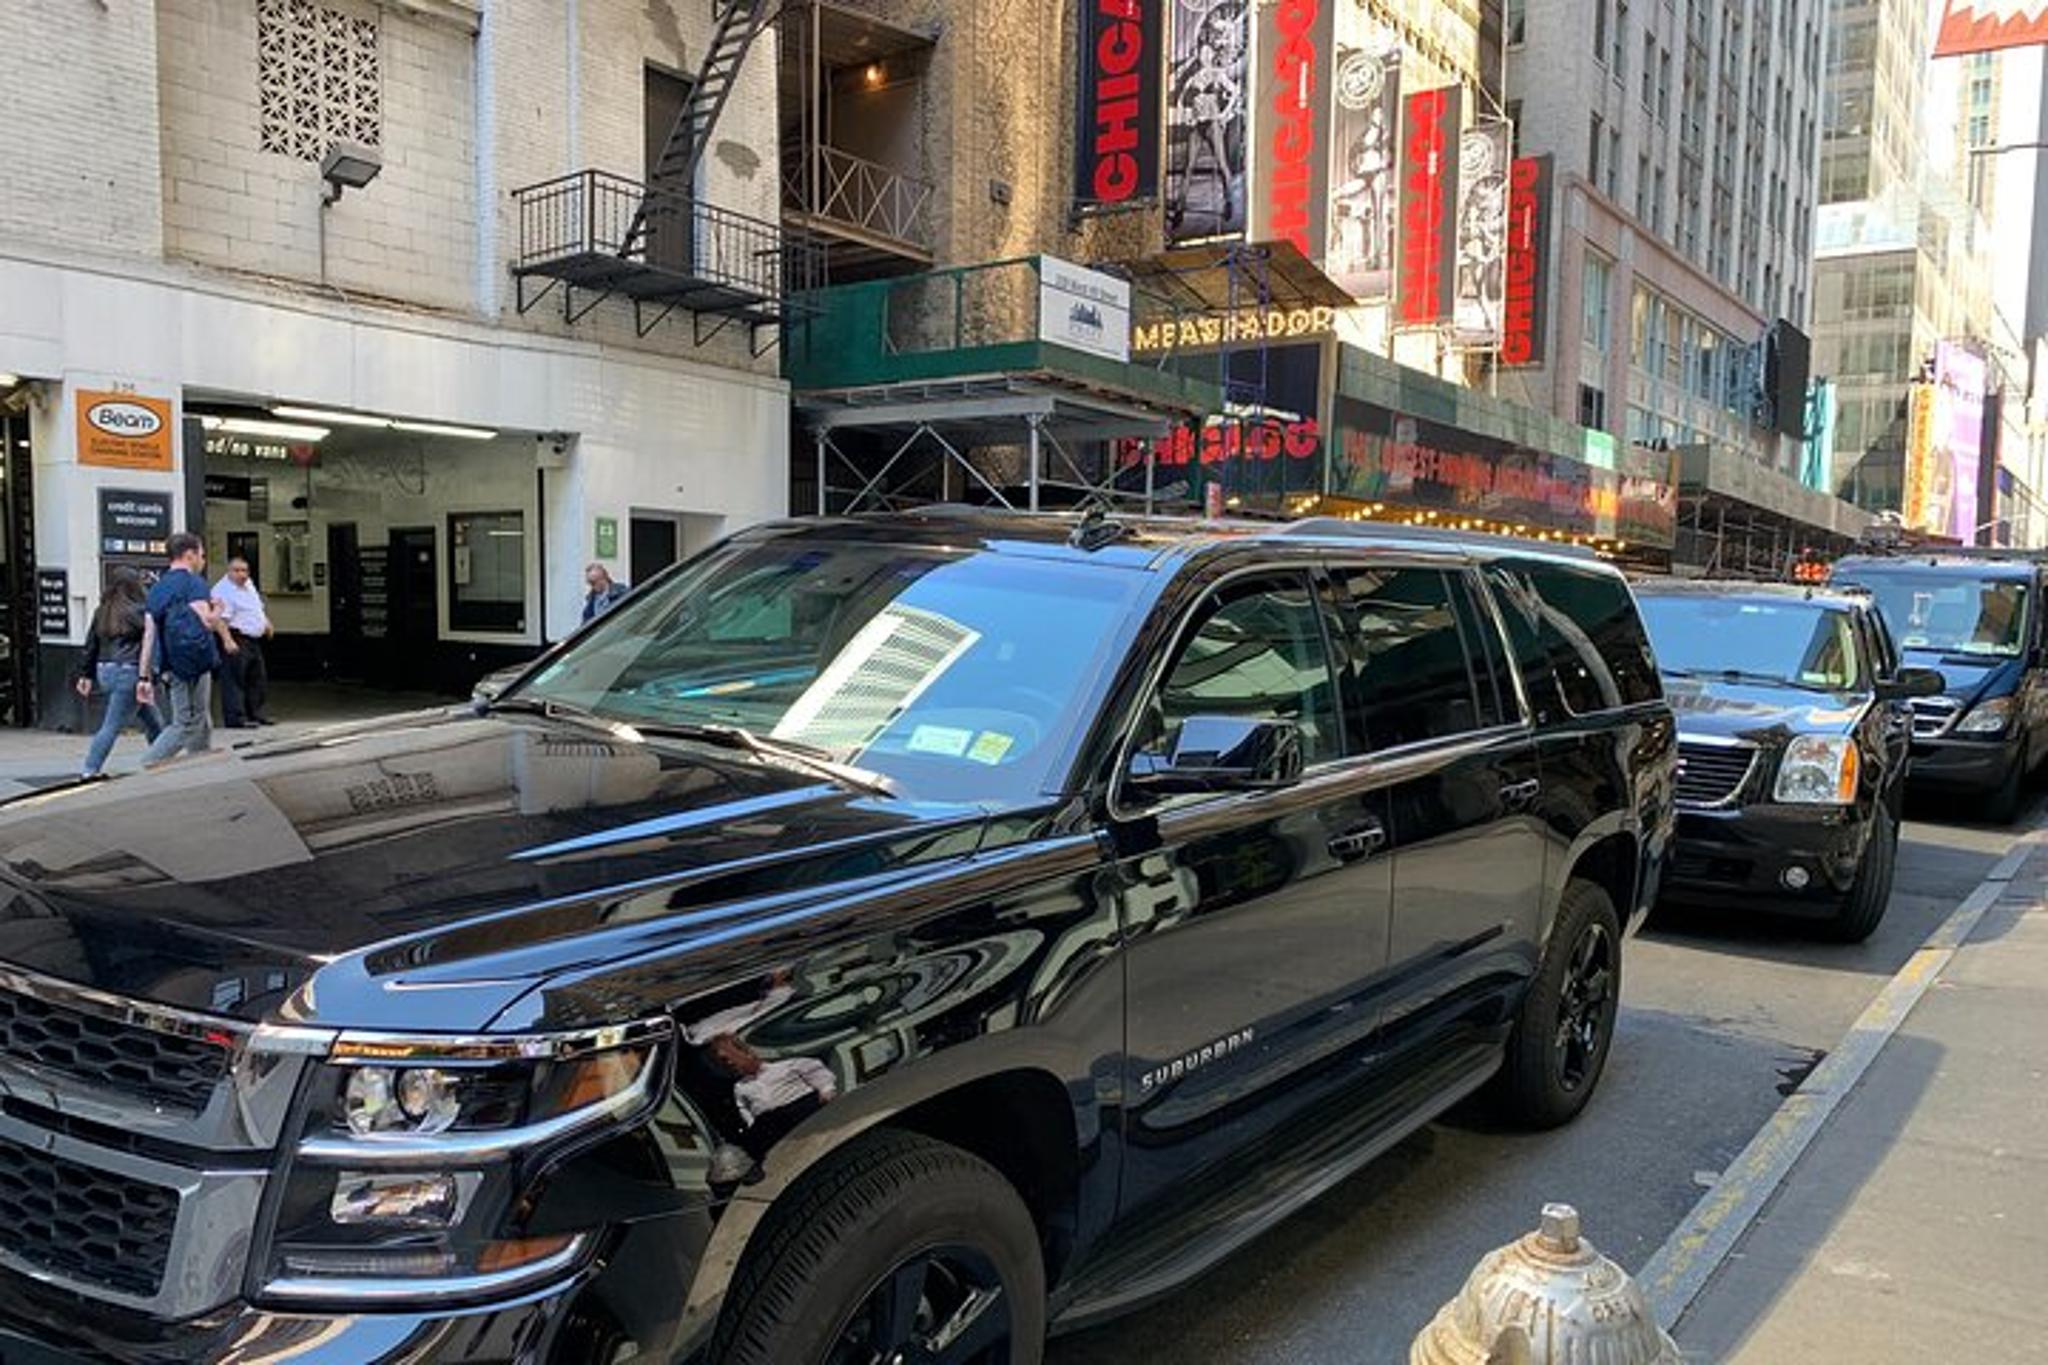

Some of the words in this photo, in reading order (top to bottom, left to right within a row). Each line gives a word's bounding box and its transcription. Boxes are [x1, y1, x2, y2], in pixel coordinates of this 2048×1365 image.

[1403, 89, 1447, 323] CHICAGO
[1501, 157, 1539, 365] CHICAGO
[99, 408, 154, 429] Beam
[255, 445, 287, 459] vans
[108, 501, 135, 514] credit
[137, 503, 163, 515] cards
[116, 516, 157, 526] welcome
[1141, 1027, 1254, 1093] SUBURBAN
